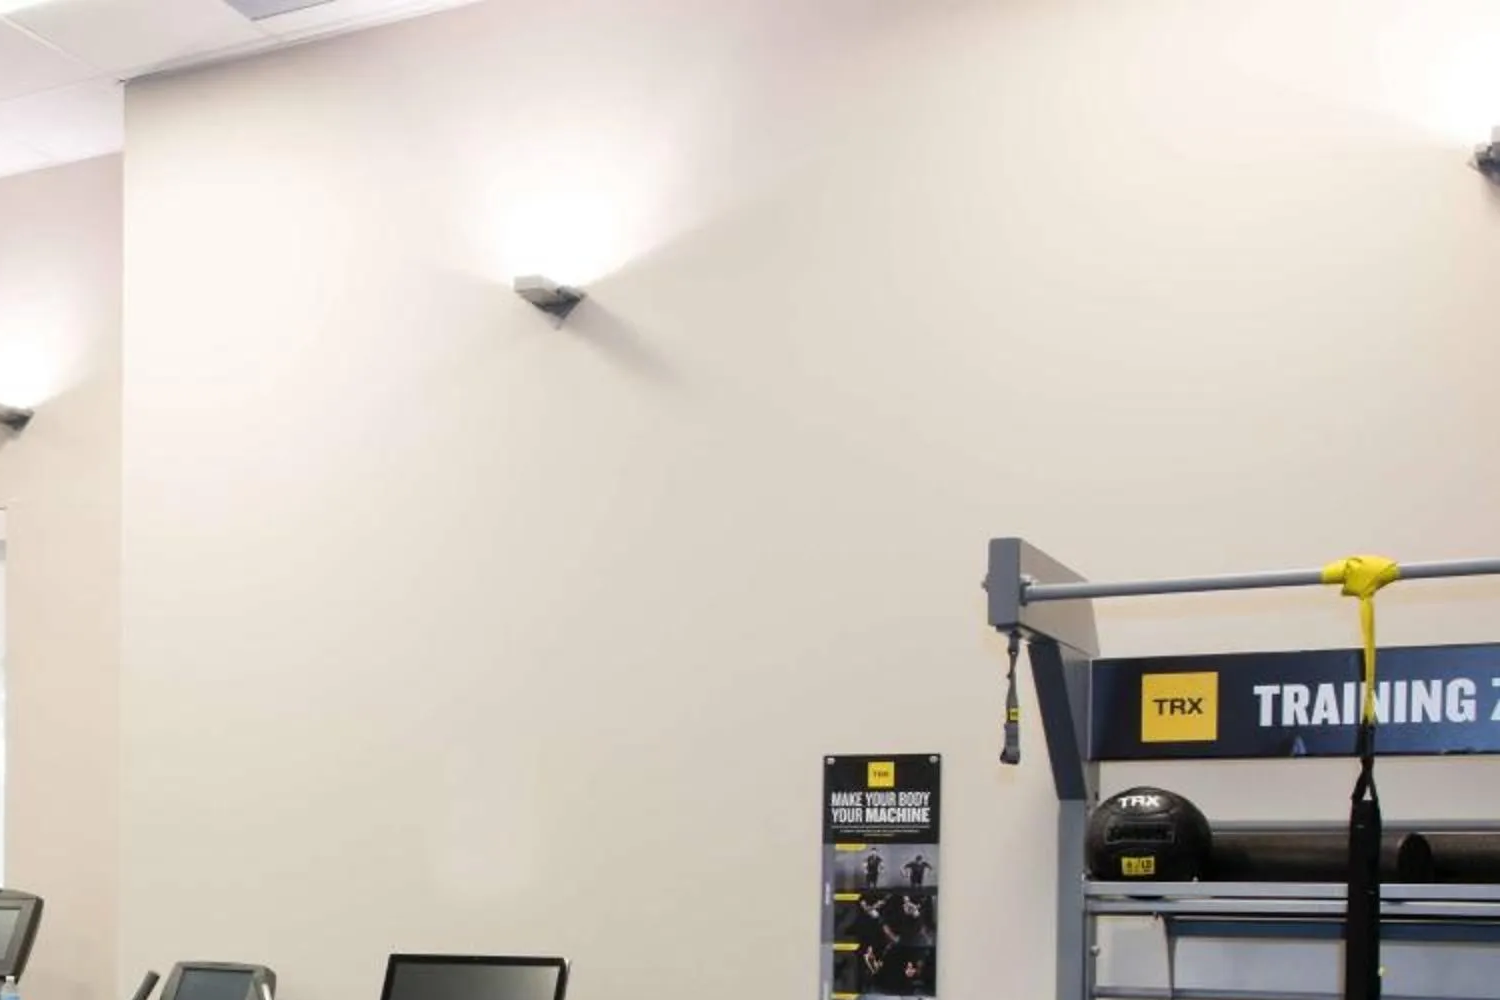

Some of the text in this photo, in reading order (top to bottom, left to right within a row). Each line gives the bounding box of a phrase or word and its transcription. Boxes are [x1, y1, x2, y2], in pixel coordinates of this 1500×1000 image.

[1151, 697, 1204, 716] TRX
[1253, 677, 1478, 727] TRAINING
[831, 791, 931, 807] MAKE YOUR BODY
[1118, 795, 1160, 809] TRX
[831, 807, 931, 823] YOUR MACHINE
